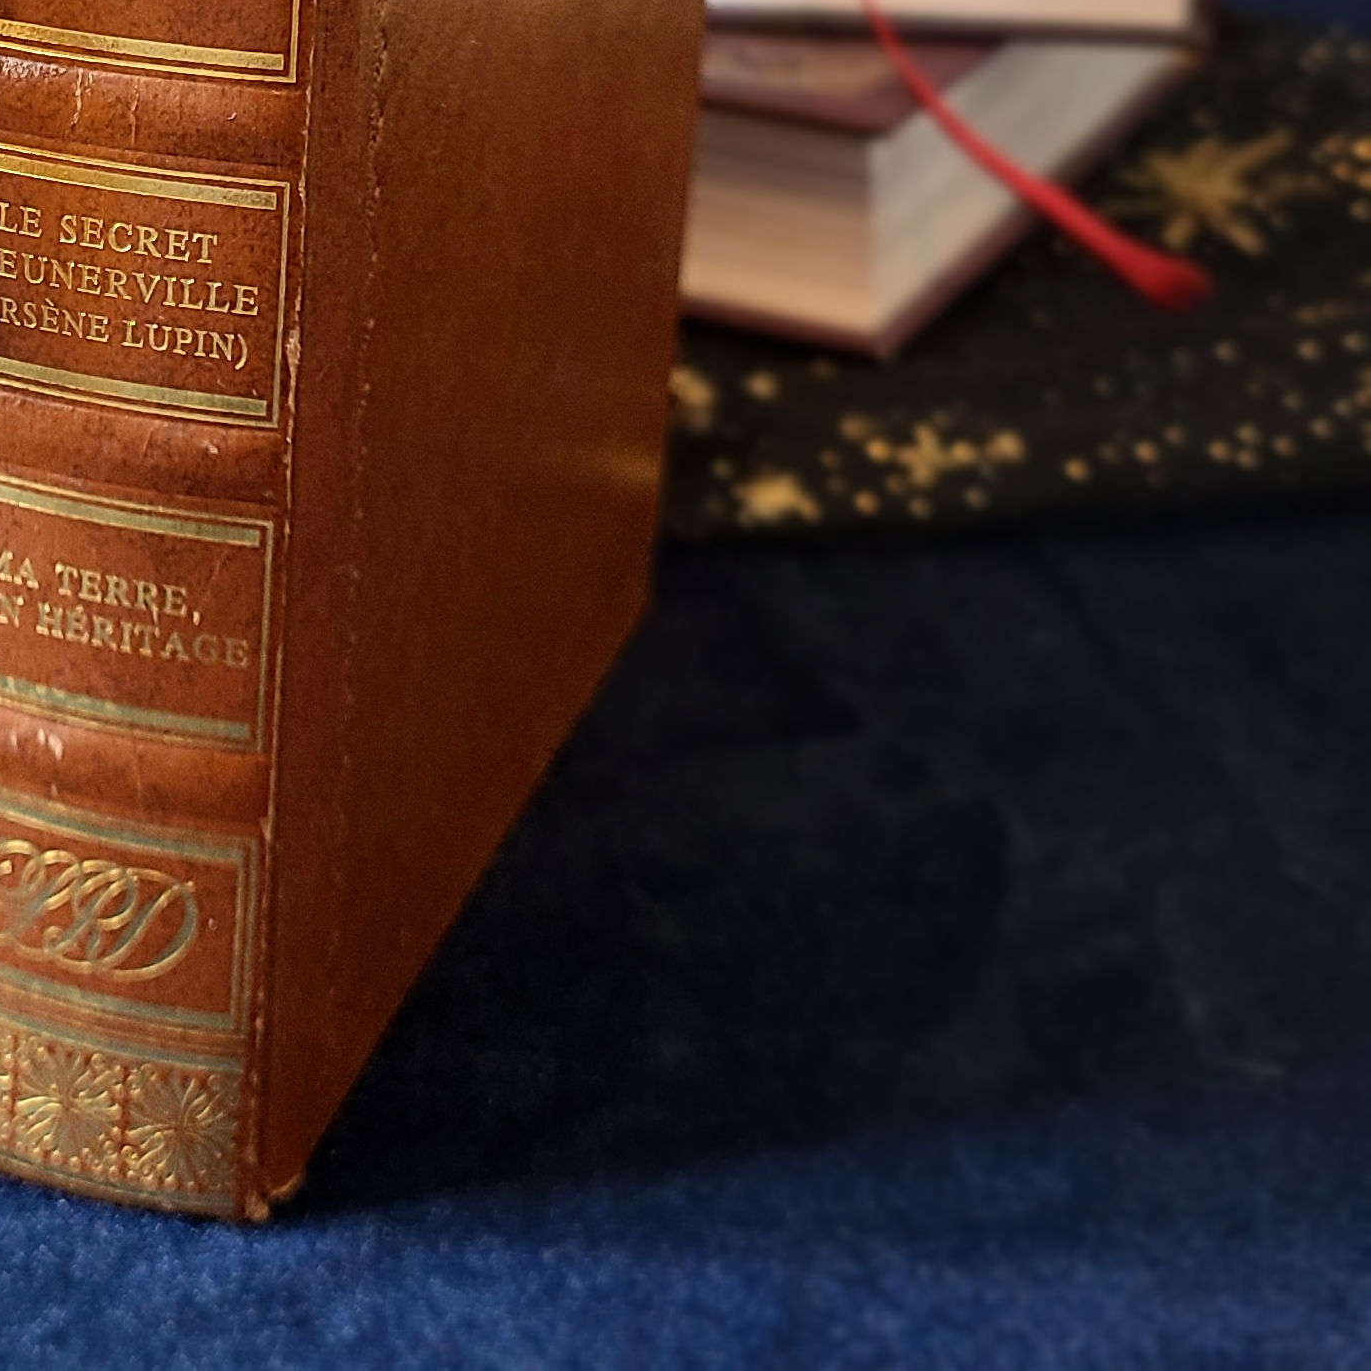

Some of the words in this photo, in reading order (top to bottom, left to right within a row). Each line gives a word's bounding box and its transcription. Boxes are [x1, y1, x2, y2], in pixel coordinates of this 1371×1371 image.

[58, 214, 219, 265] SECRET
[120, 318, 249, 371] LUPIN)
[54, 560, 203, 627] TERRE,
